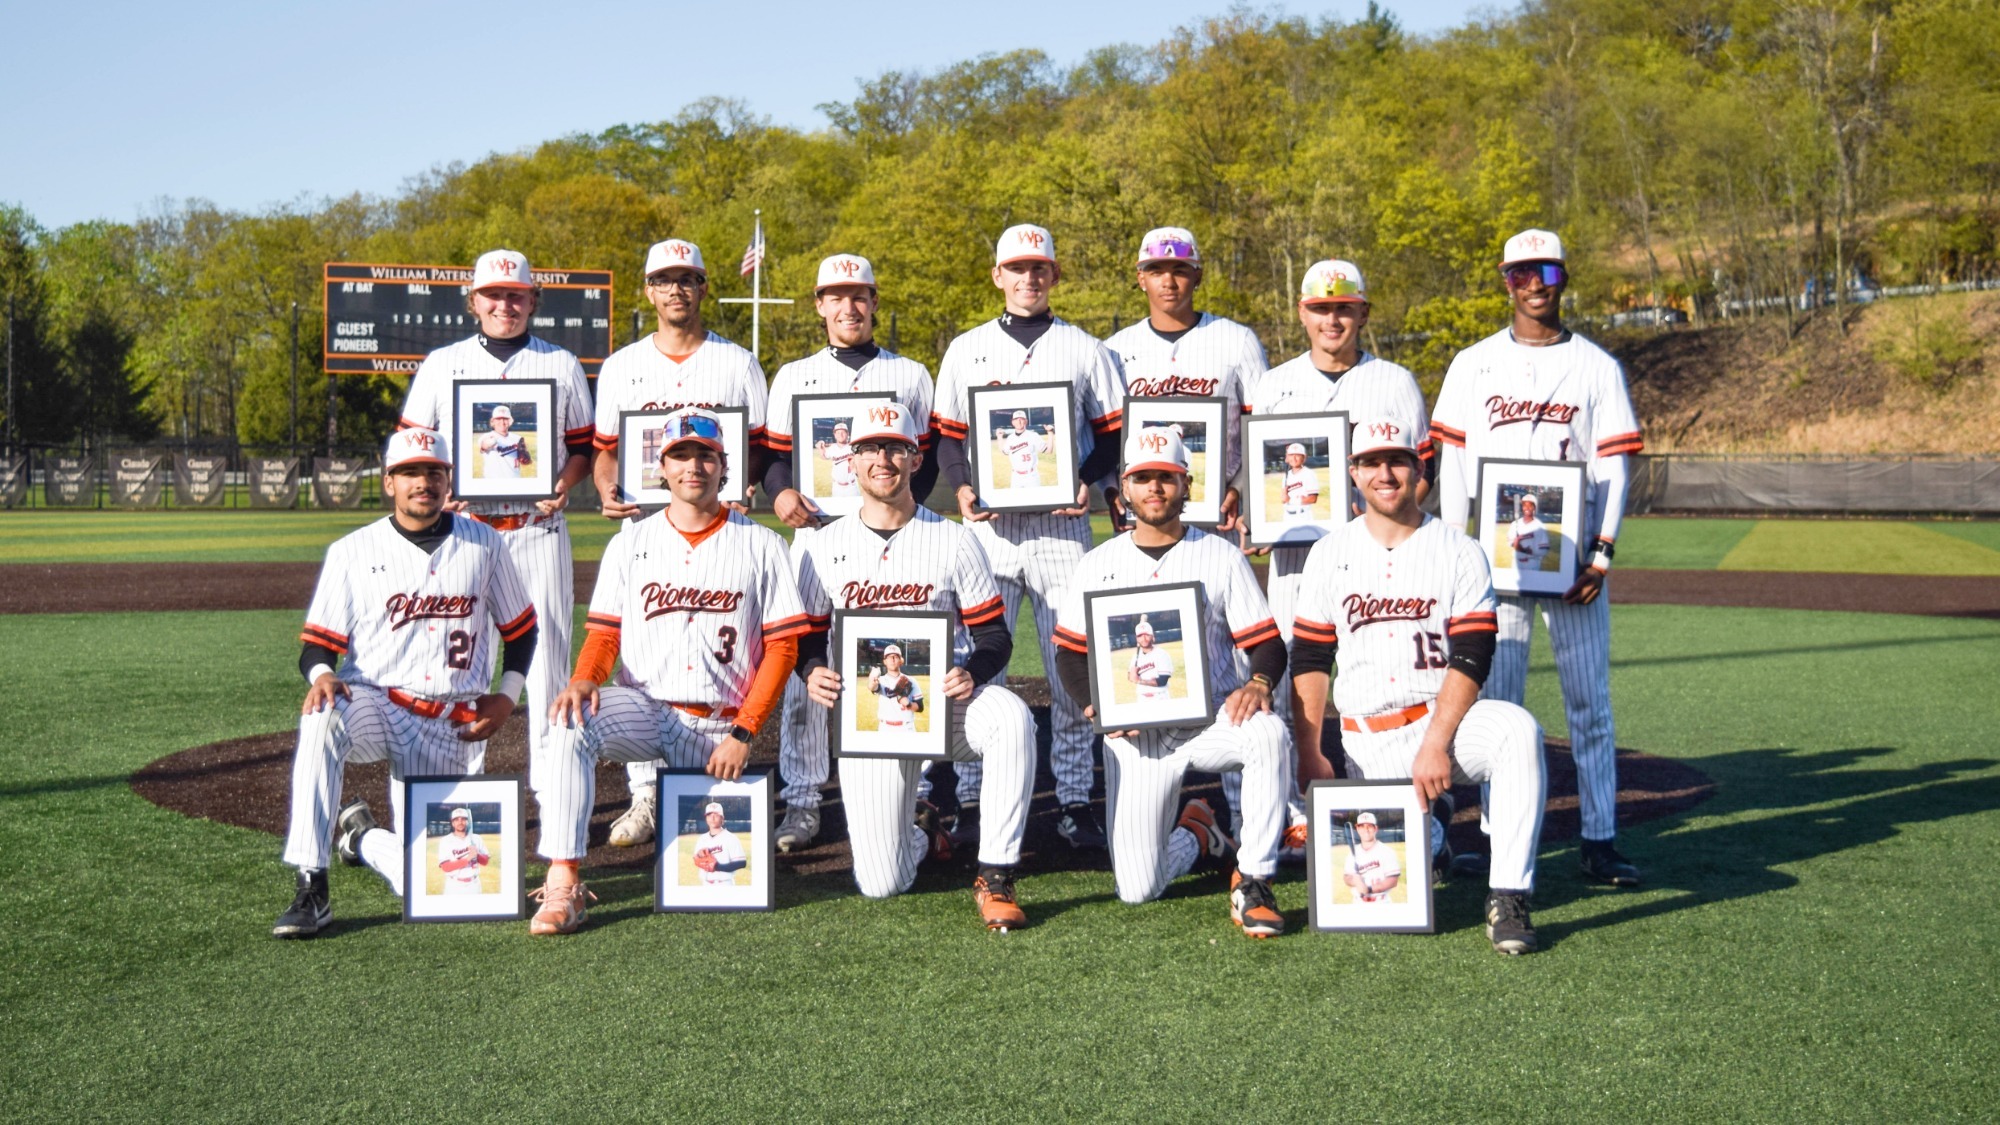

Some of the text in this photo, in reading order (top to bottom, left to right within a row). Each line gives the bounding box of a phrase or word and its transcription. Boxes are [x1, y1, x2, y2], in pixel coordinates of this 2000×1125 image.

[1017, 230, 1044, 249] WP
[1518, 235, 1545, 252] WP
[664, 243, 691, 260] WP
[371, 266, 570, 284] WILLIAM PATERS ERSITY
[489, 257, 517, 277] WP
[832, 260, 860, 278] WP
[342, 282, 374, 294] AT BAT
[408, 284, 432, 295] BALL
[336, 322, 375, 336] GUEST
[393, 314, 399, 324] 1
[404, 314, 411, 324] 2
[416, 314, 423, 324] 3
[432, 314, 440, 325] 4
[444, 315, 451, 325] 5
[533, 317, 555, 328] RUNS
[333, 338, 379, 353] PIONEERS
[372, 358, 423, 372] WELCO
[1129, 375, 1219, 397] Pioneers
[868, 406, 899, 428] WP
[1485, 395, 1580, 431] Pioneers
[404, 431, 436, 451] WP
[1368, 422, 1400, 441] WP
[1138, 433, 1168, 454] WP
[641, 582, 744, 621] Pioneers
[840, 579, 935, 610] Pioneers
[386, 591, 478, 632] Pioneers
[1342, 593, 1438, 633] Pioneers
[448, 629, 477, 670] 21
[714, 625, 738, 665] 3
[1412, 631, 1448, 670] 15
